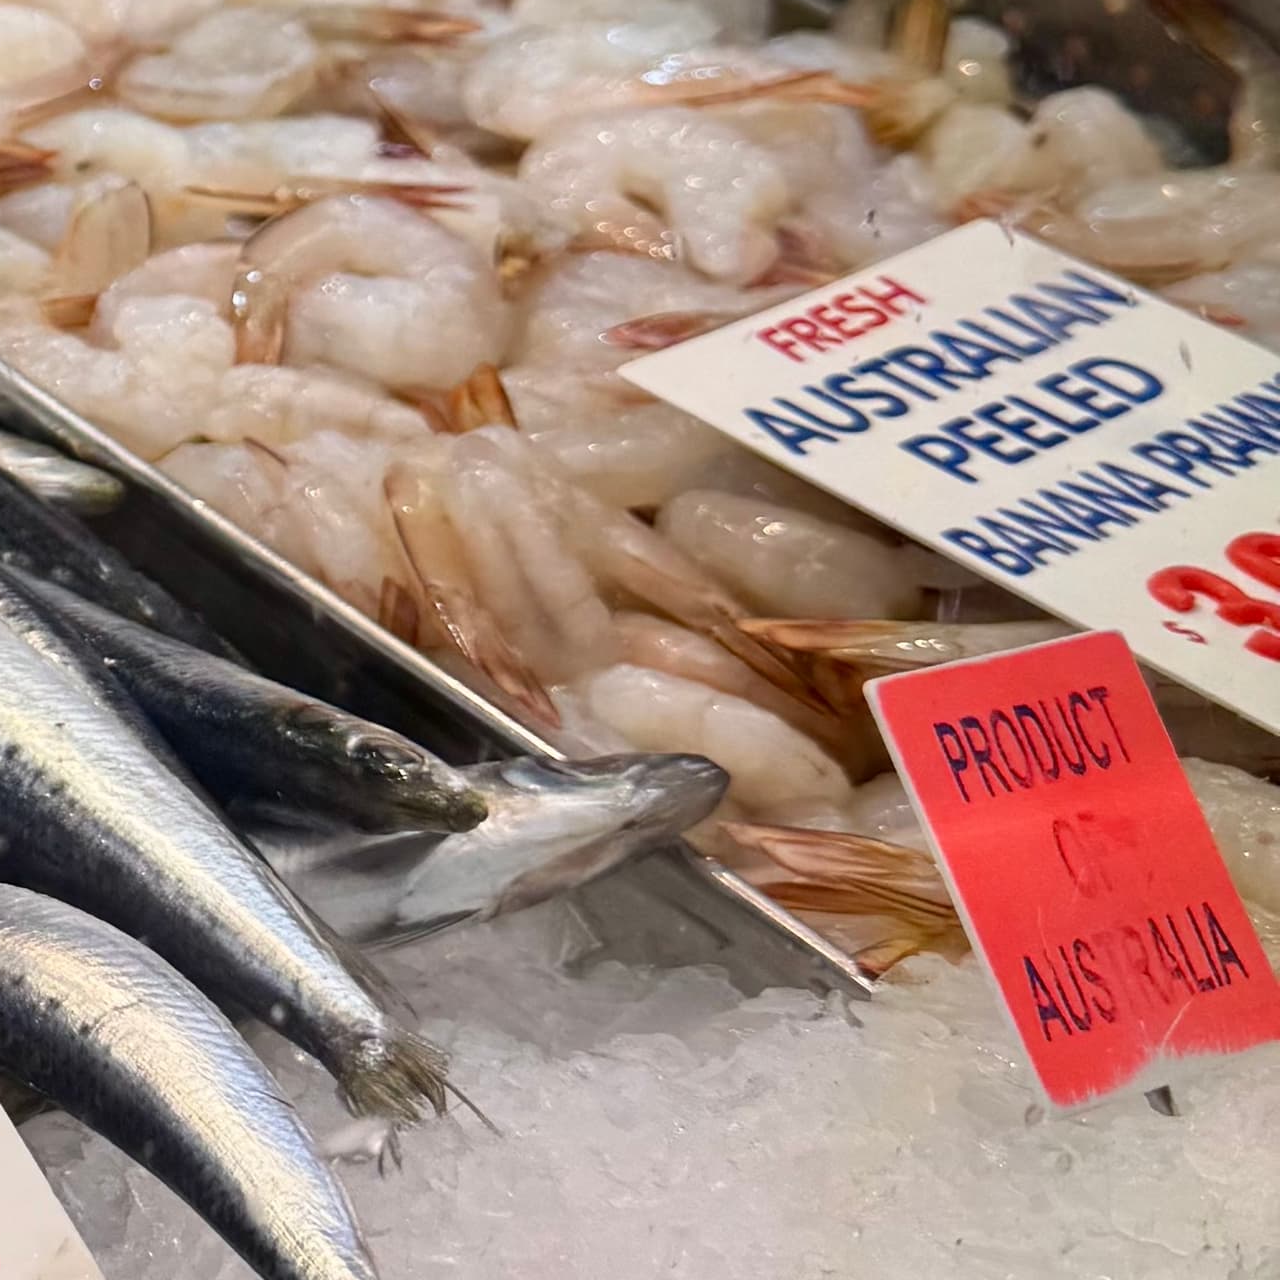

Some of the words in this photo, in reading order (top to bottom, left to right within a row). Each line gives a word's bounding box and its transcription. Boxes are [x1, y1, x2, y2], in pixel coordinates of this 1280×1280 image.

[743, 269, 1139, 456] AUSTRALIAN
[757, 275, 928, 362] FRESH
[897, 356, 1165, 484] PEELED
[940, 460, 1193, 577] BANANA
[1129, 372, 1280, 488] PRAW
[933, 686, 1131, 802] PRODUCT
[1023, 901, 1250, 1041] AUSTRALIA
